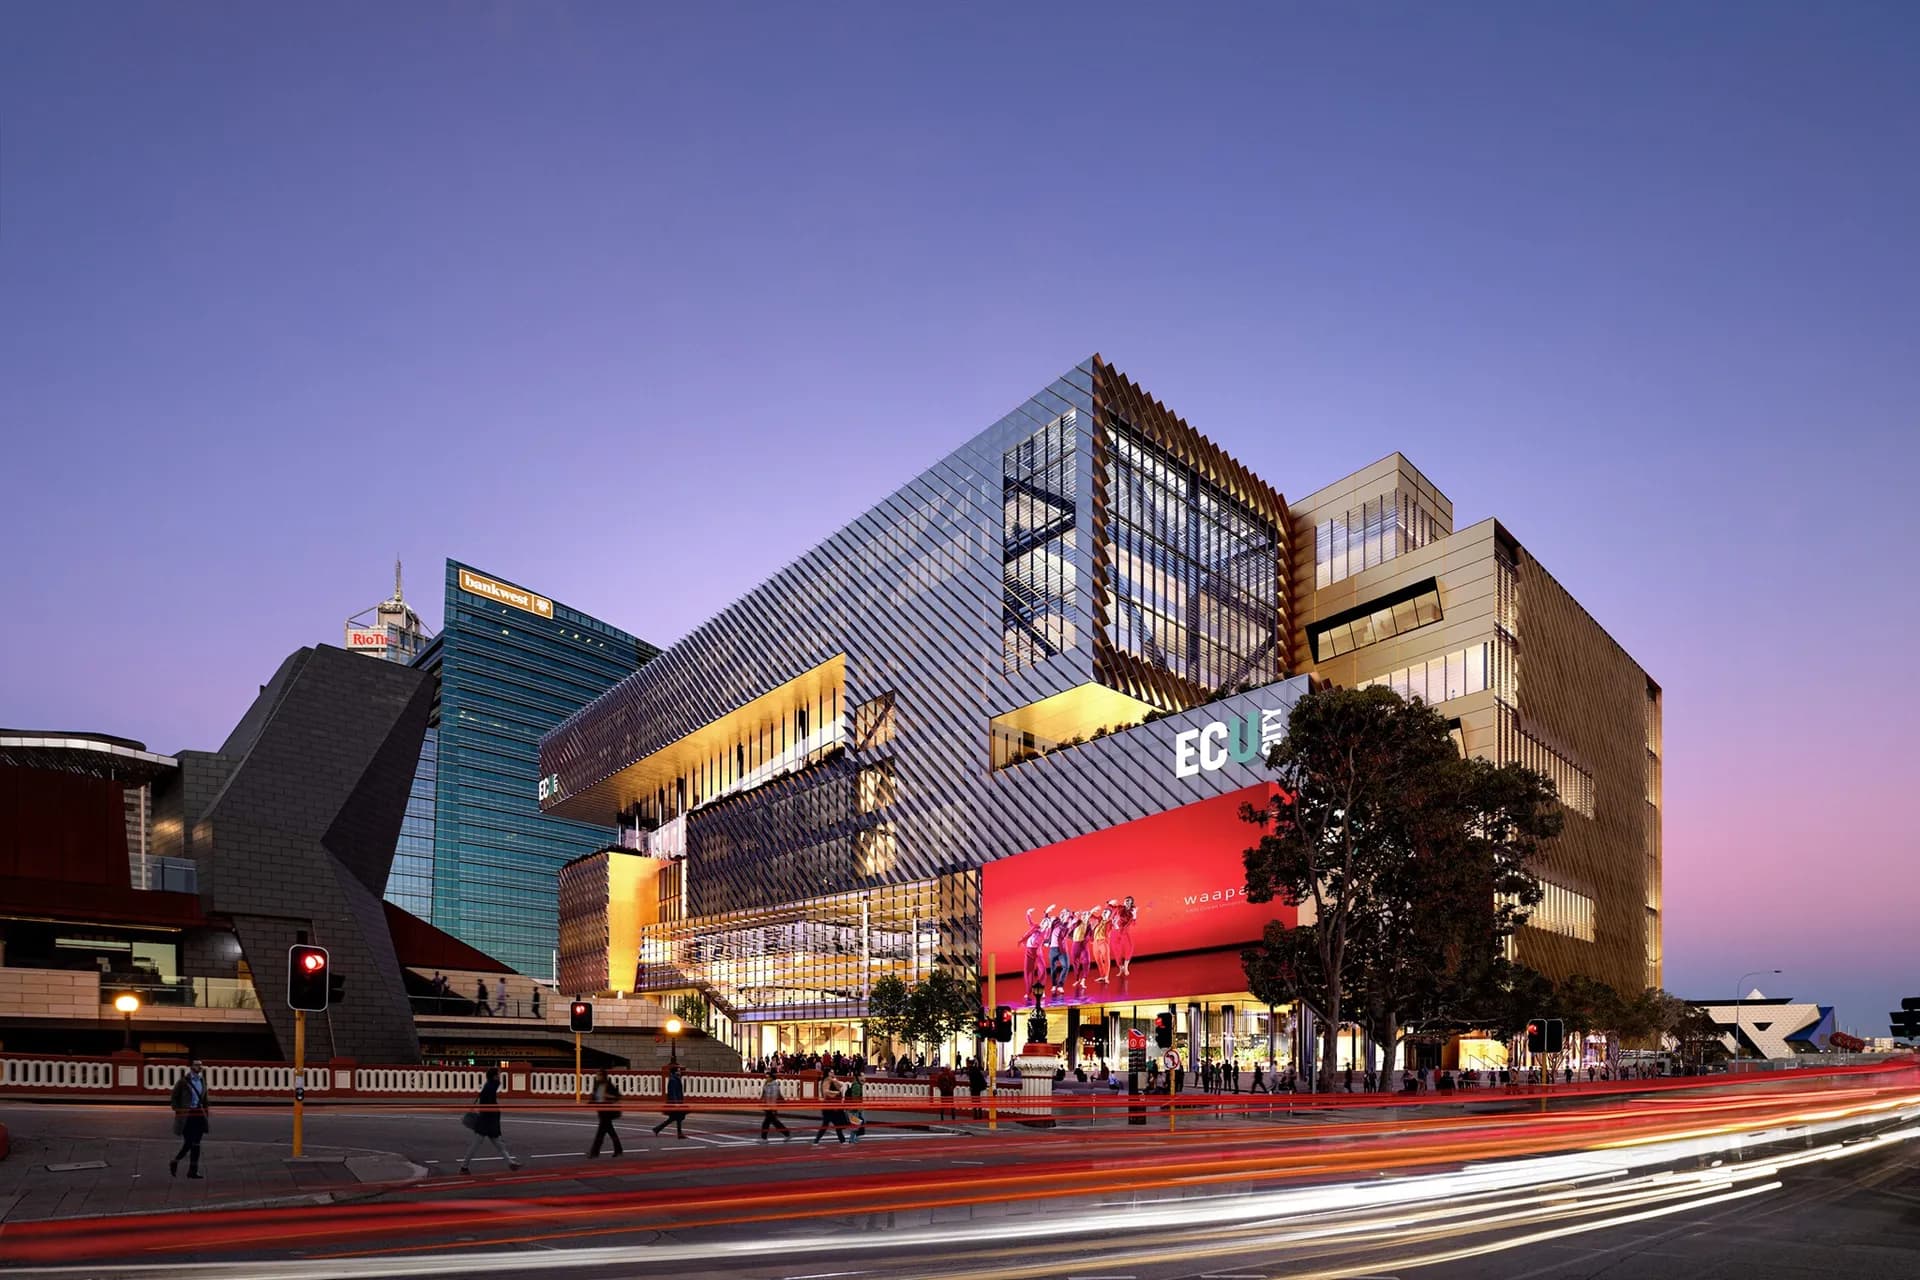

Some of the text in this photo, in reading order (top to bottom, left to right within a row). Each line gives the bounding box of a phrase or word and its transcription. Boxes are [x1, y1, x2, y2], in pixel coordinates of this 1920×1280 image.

[465, 574, 529, 606] bankwest
[1176, 709, 1258, 778] ECU
[1262, 708, 1282, 756] CITY
